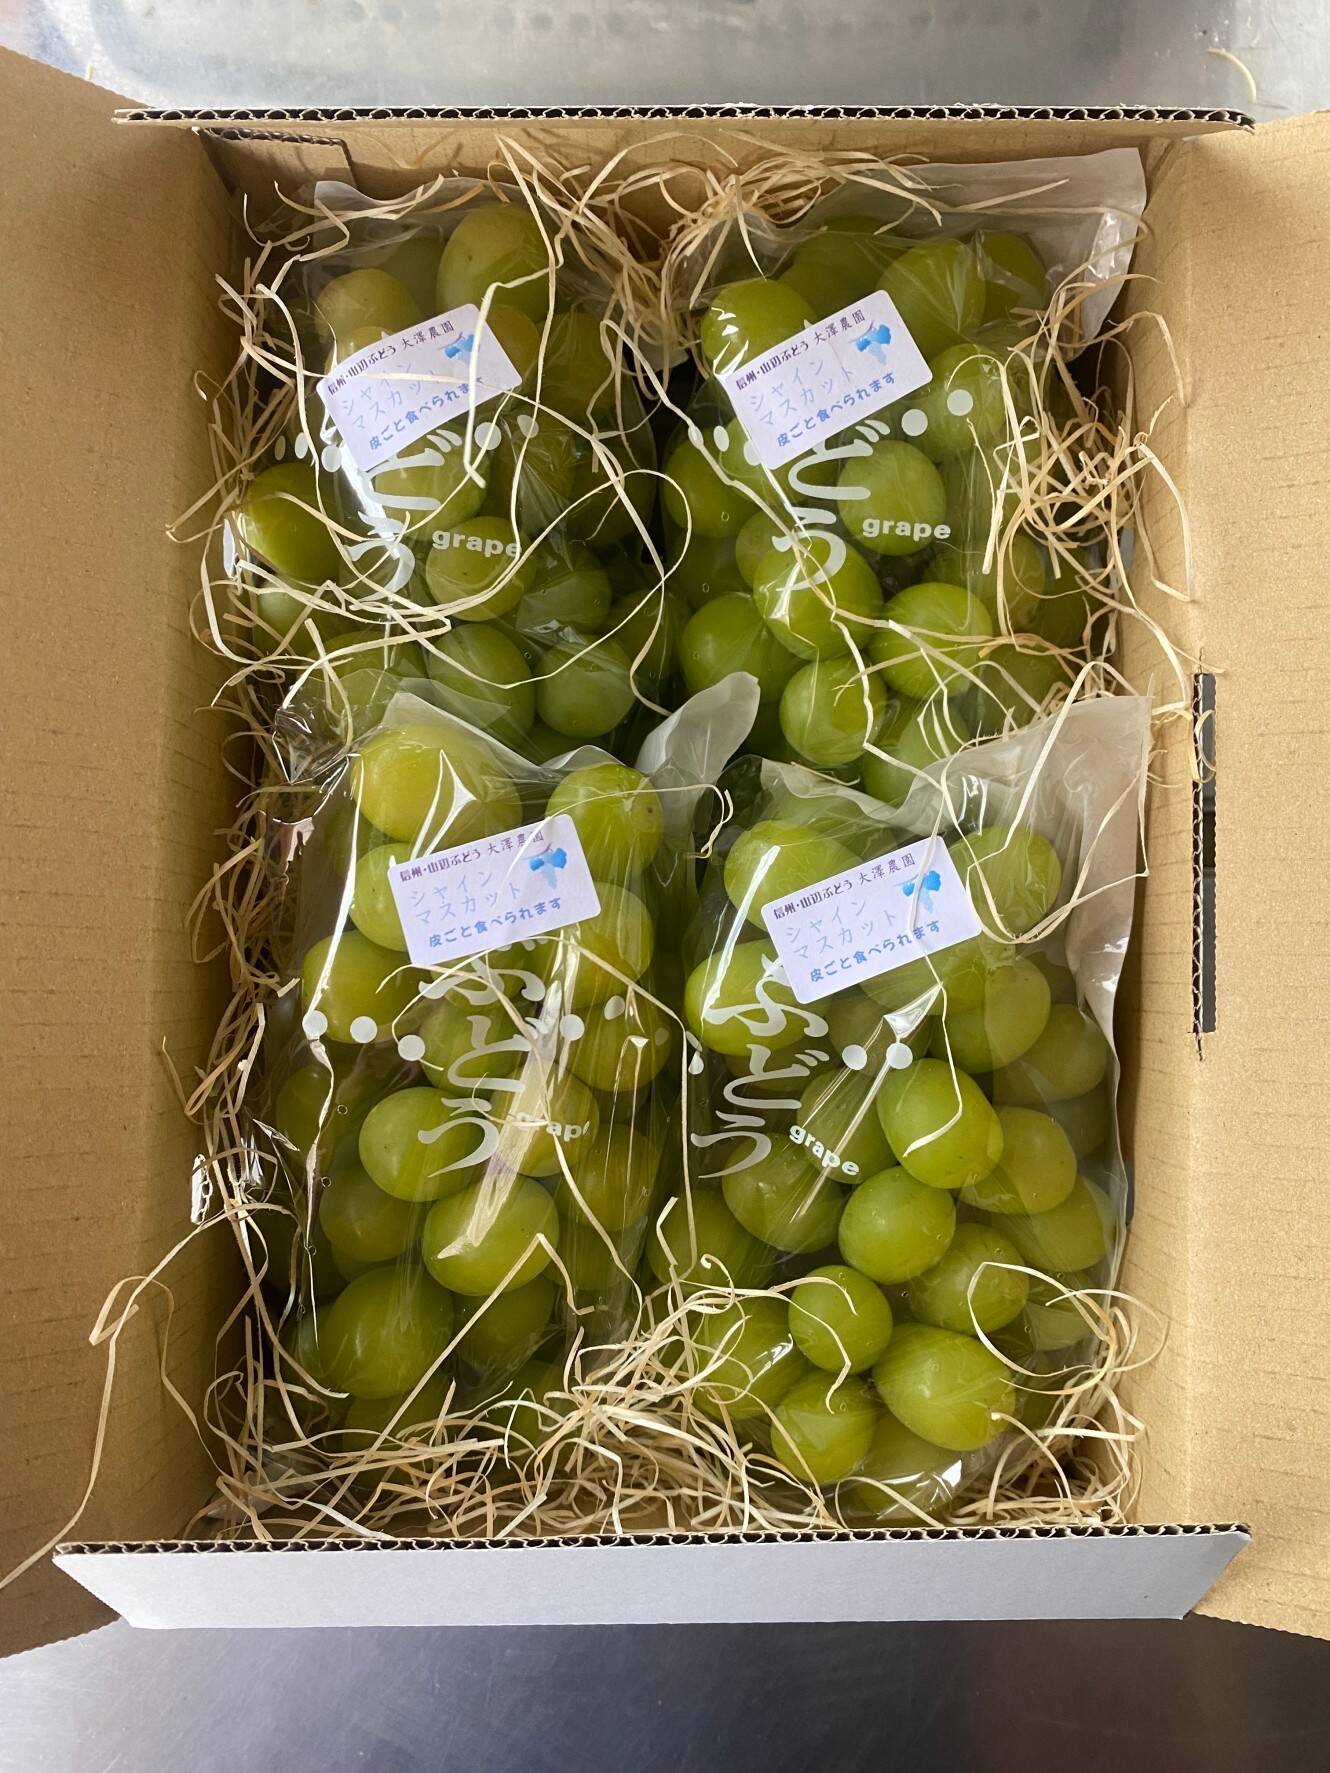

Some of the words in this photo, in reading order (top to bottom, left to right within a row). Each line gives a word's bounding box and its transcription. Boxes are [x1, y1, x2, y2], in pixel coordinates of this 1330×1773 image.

[352, 369, 440, 431] マスカッ
[750, 358, 824, 412] シャイン
[760, 366, 854, 427] マスカット
[777, 371, 896, 447] 皮ごと食べられます
[432, 530, 522, 557] grape
[862, 517, 951, 542] grape
[410, 871, 493, 907] シャイン
[416, 882, 521, 925] マスカット
[428, 897, 562, 948] 皮ごと食べられます
[785, 899, 867, 944] シャイン
[794, 908, 897, 960] マスカット
[810, 920, 941, 983] 皮ごと食べられます
[789, 1124, 860, 1176] grape
